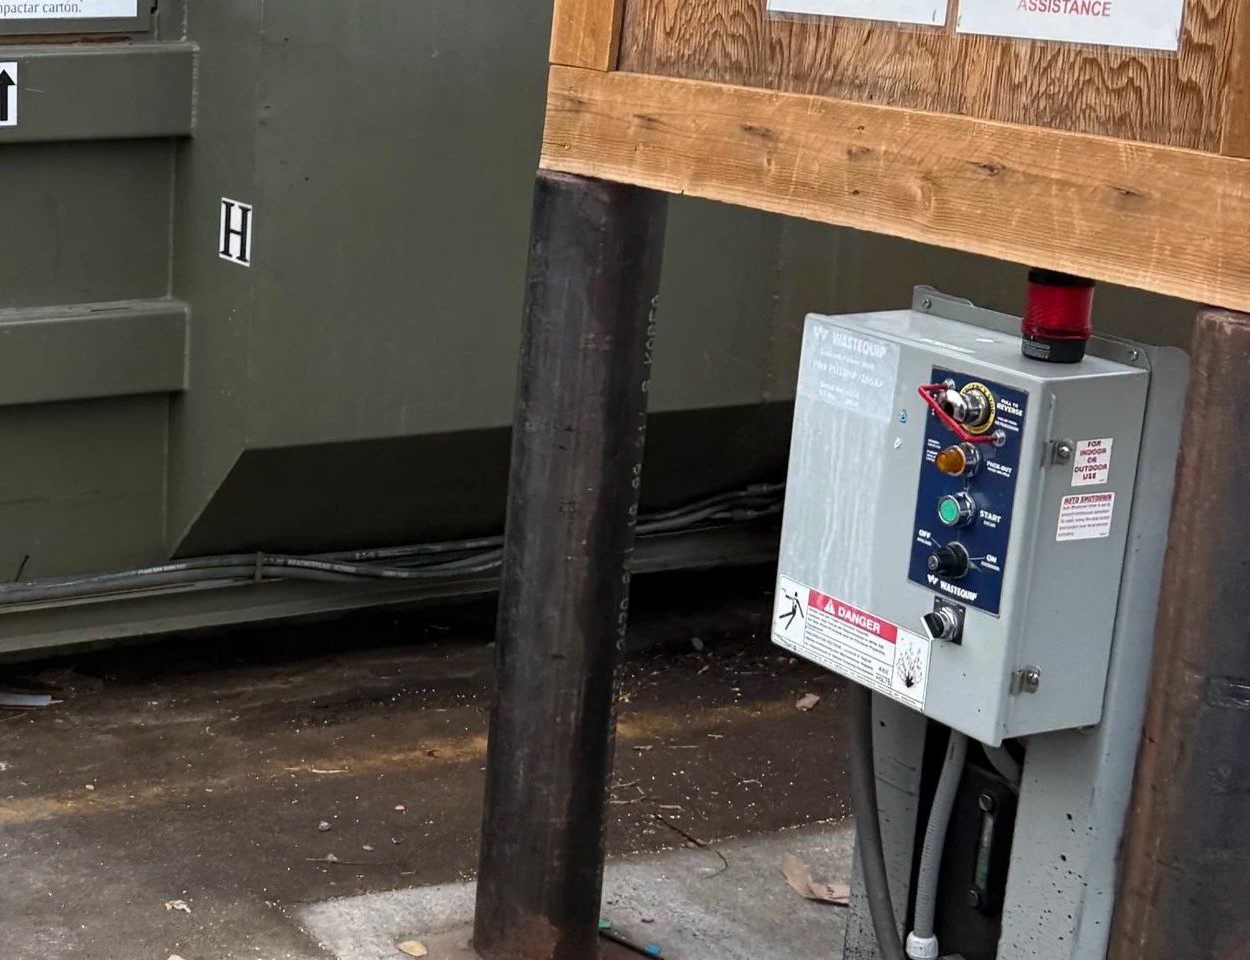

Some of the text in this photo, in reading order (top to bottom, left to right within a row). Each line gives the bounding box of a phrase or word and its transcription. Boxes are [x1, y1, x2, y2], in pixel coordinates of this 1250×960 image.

[42, 1, 81, 14] cartón.
[220, 201, 251, 263] H
[832, 330, 887, 359] WASTEQUIP
[996, 403, 1023, 417] REVERSE
[1087, 440, 1101, 448] FOR
[1080, 448, 1107, 456] INDOOR
[1087, 456, 1097, 464] OR
[1074, 464, 1107, 472] OUTDOOR
[980, 510, 1002, 523] START
[918, 529, 931, 539] OFF
[986, 554, 997, 563] ON
[940, 580, 978, 601] WASTEQUIP
[838, 606, 881, 634] DANGER
